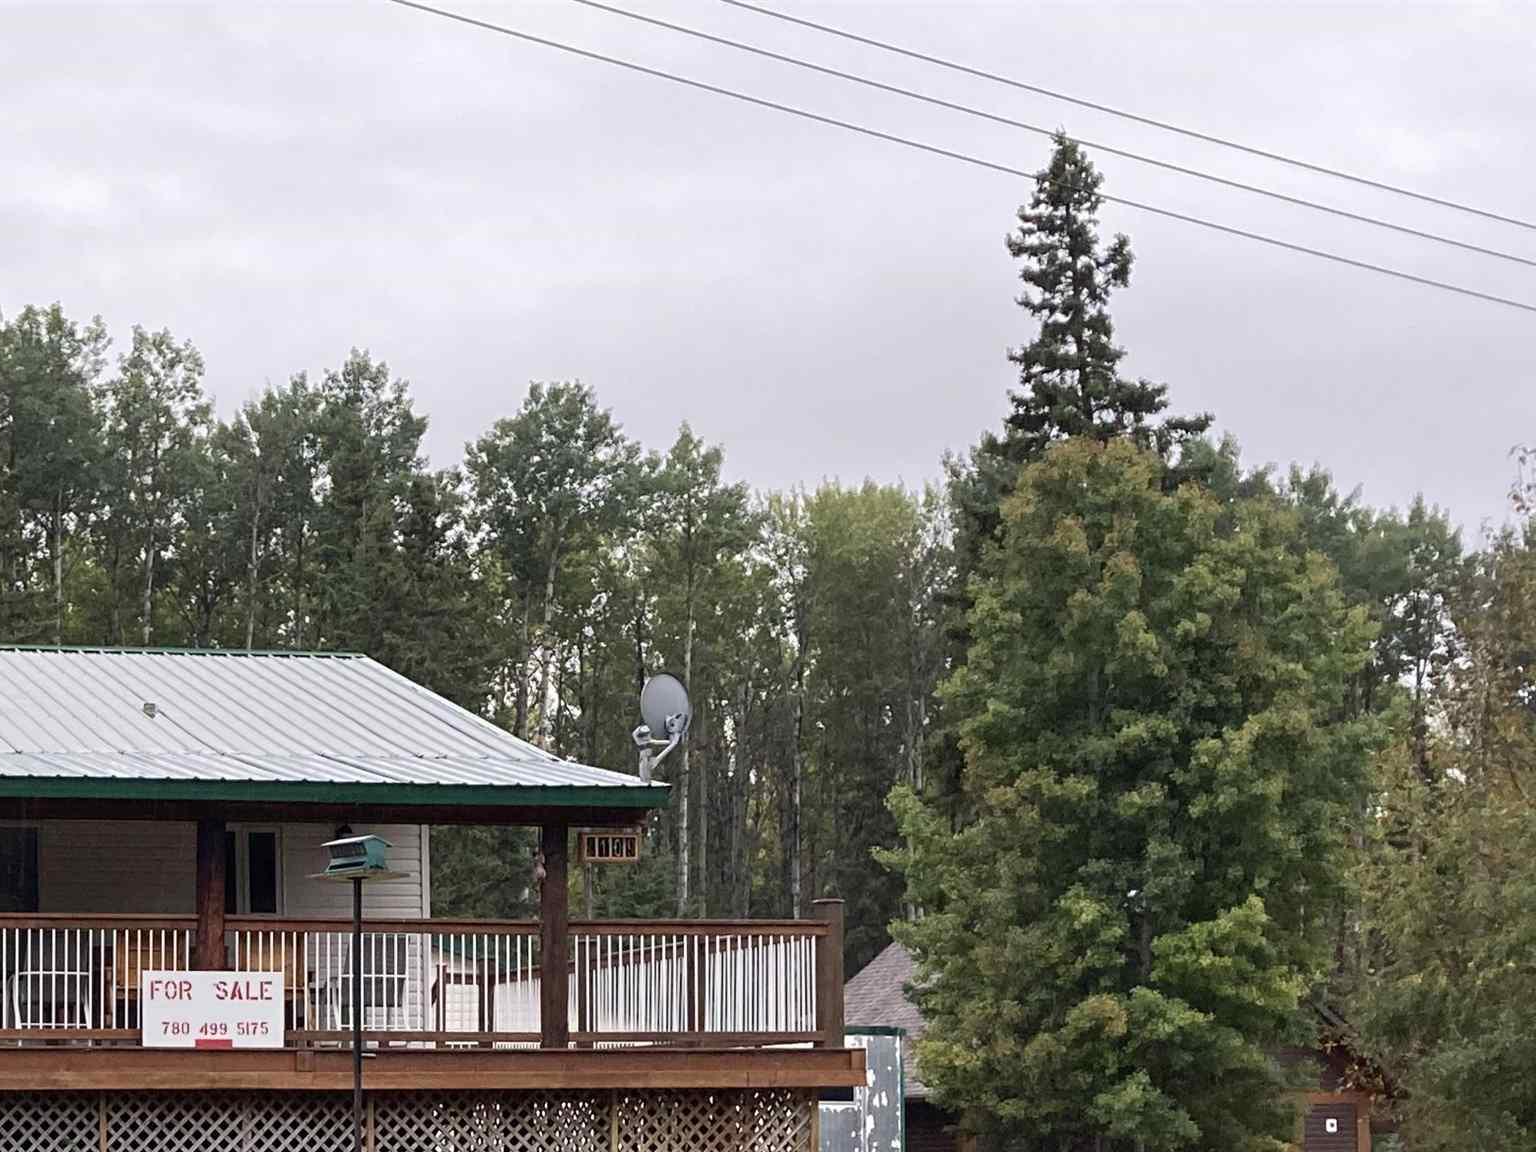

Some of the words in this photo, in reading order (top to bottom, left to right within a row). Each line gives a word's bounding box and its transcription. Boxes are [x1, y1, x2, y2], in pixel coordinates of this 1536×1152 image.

[150, 980, 192, 1000] FOR
[214, 981, 272, 1000] SALE
[162, 1021, 190, 1035] 780
[199, 1022, 228, 1036] 499
[237, 1022, 269, 1036] 5175
